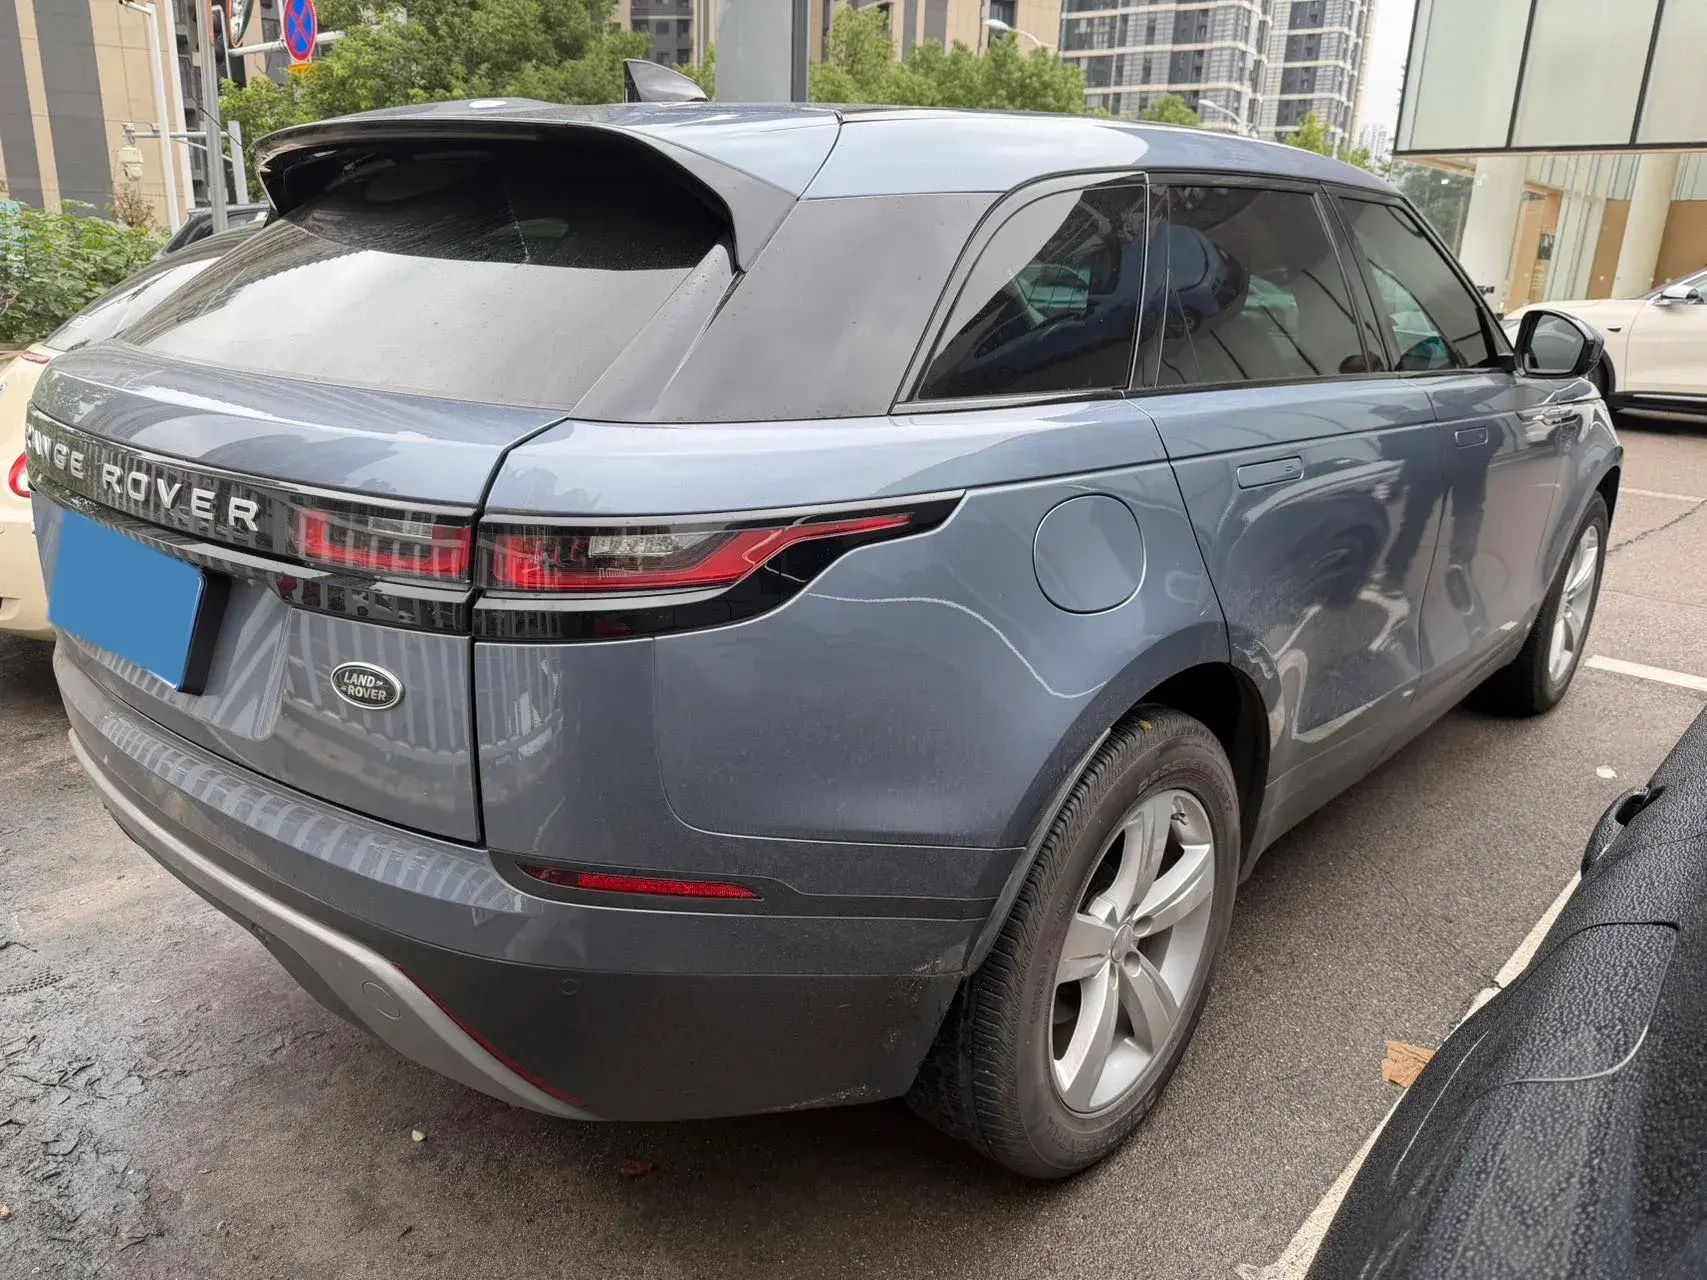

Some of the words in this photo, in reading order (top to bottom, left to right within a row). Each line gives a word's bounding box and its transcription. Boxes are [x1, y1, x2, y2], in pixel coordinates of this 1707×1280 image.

[102, 463, 259, 532] ROVER
[343, 671, 376, 688] LAND
[347, 684, 387, 702] ROVER
